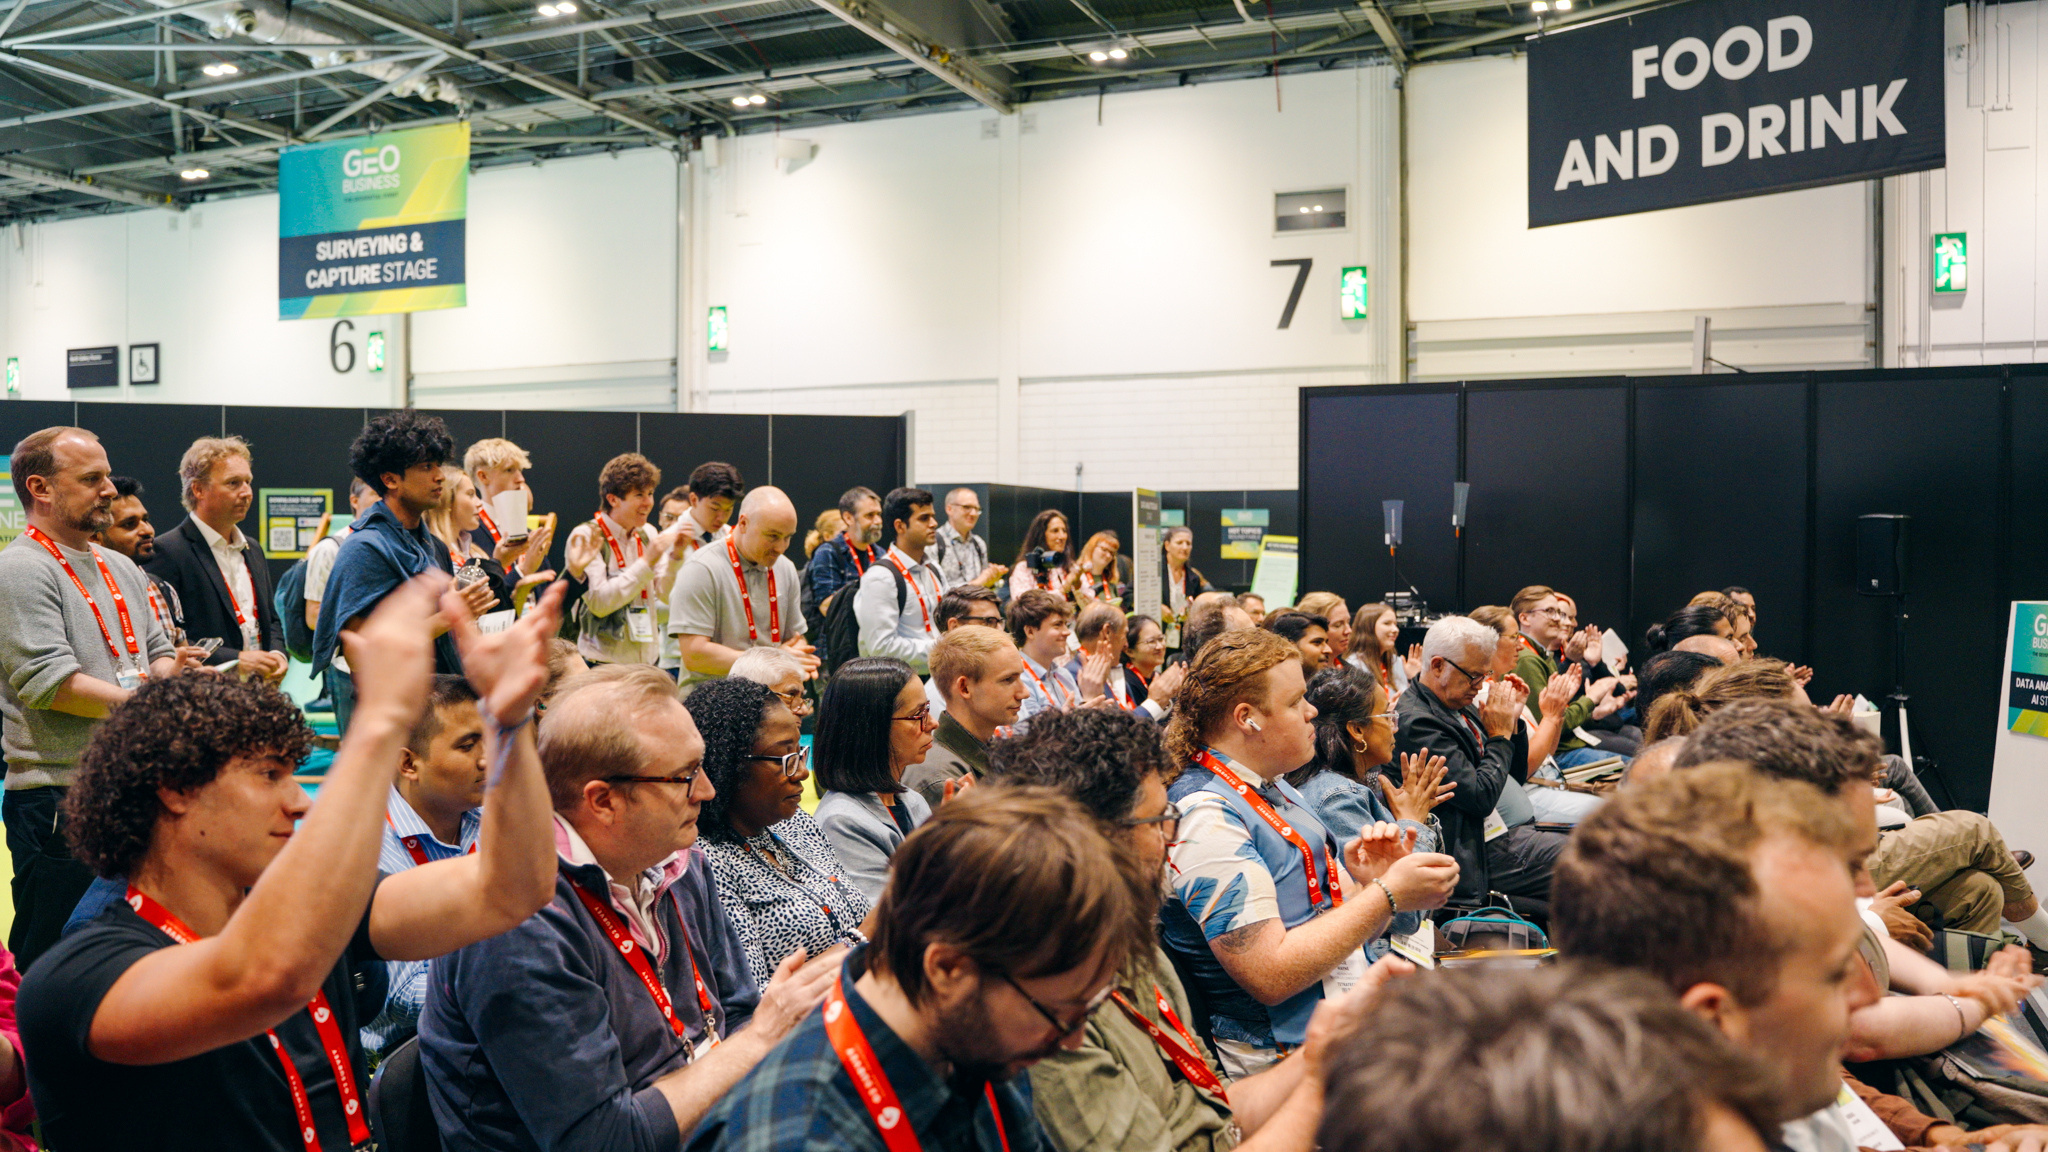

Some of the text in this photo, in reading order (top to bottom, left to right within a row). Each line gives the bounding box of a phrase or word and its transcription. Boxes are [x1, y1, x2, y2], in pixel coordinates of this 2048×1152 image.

[1632, 15, 1813, 100] FOOD
[1554, 78, 1908, 191] AND DRINK
[343, 144, 401, 177] GEO
[342, 173, 400, 194] BUSINESS
[316, 231, 424, 261] SURVEYING &
[306, 258, 438, 289] CAPTURE STAGE
[1270, 258, 1312, 329] 7
[330, 319, 356, 373] 6
[2034, 613, 2048, 636] G
[2016, 677, 2034, 690] DATA
[2031, 694, 2039, 705] AI
[1212, 765, 1230, 781] SURVEY
[1256, 805, 1274, 822] SURVEY
[594, 906, 614, 931] SURVEY
[160, 923, 188, 946] URVEY
[331, 1049, 347, 1082] SURVEY
